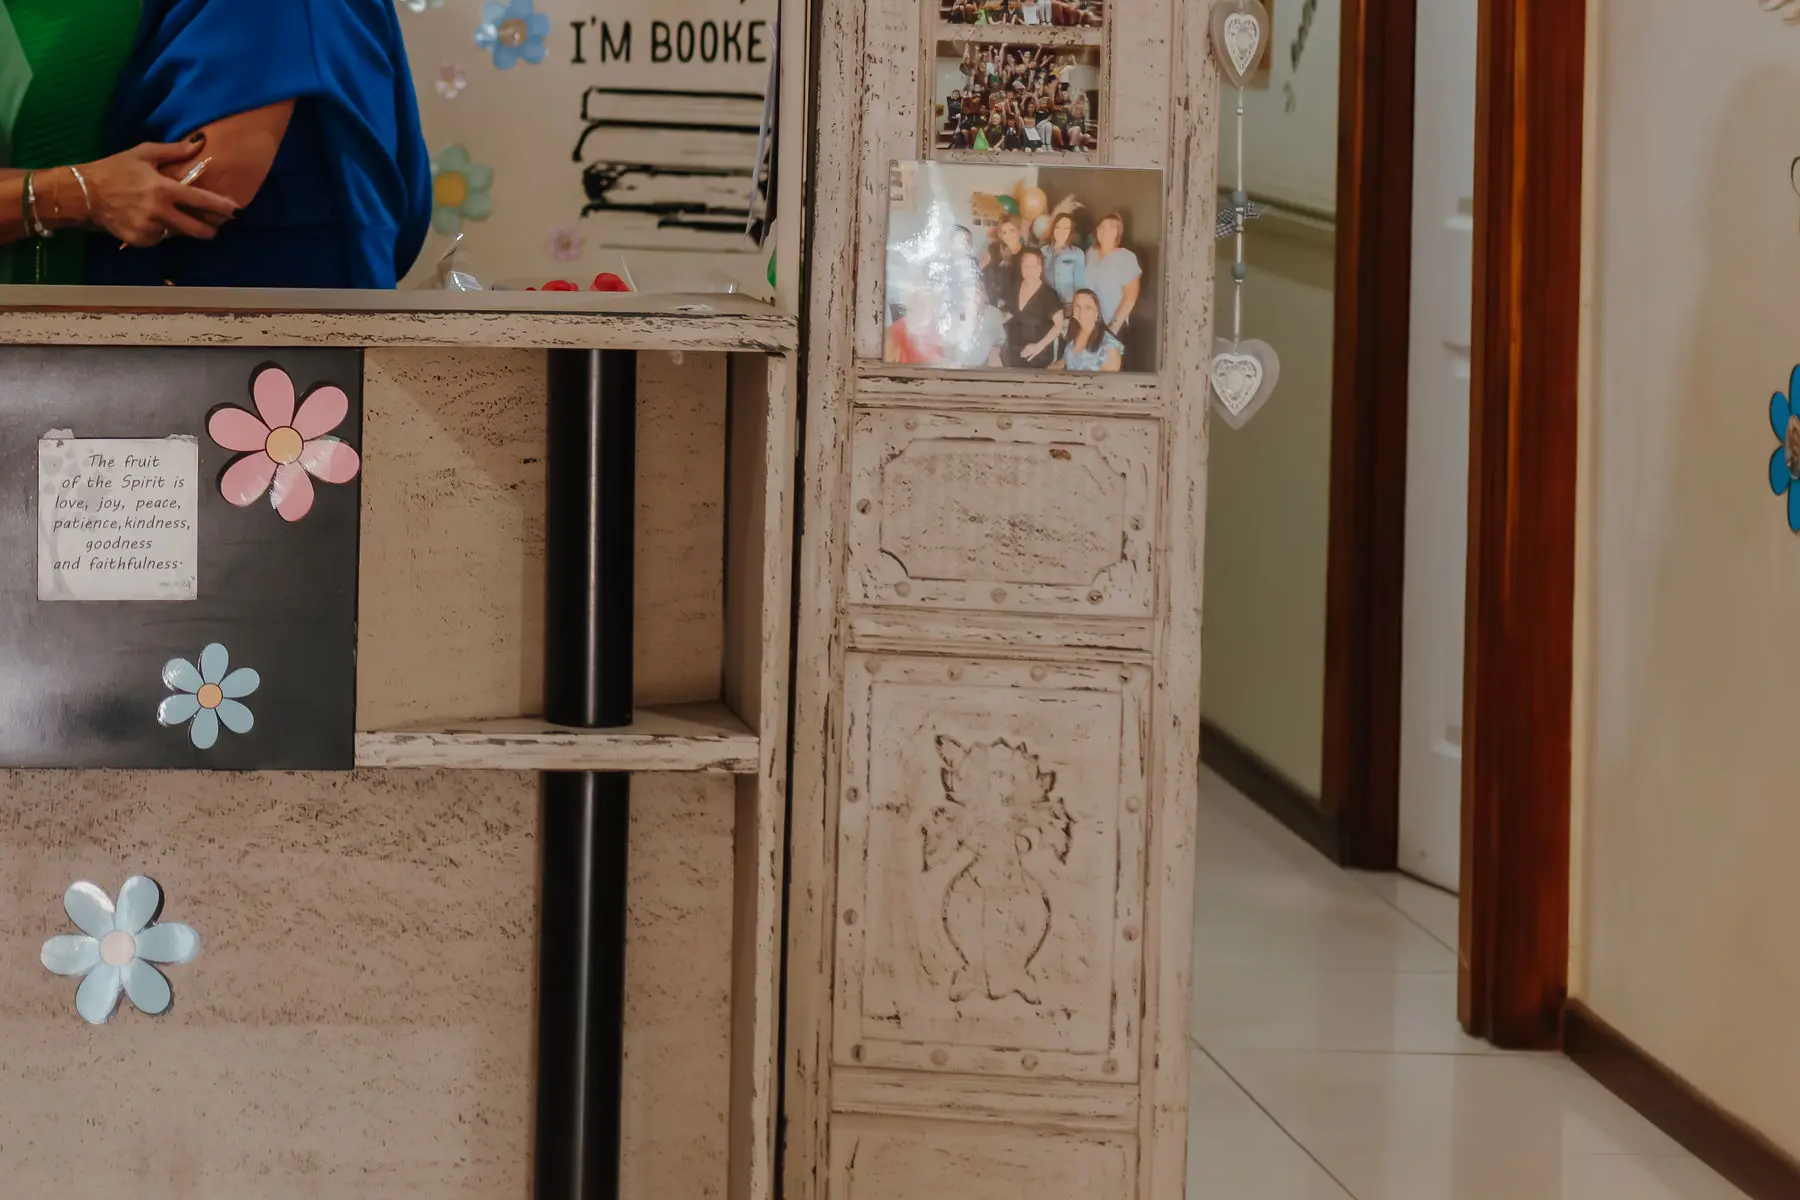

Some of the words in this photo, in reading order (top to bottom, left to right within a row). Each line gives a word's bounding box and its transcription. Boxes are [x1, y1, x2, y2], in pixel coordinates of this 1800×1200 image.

[570, 16, 632, 64] I'M
[651, 20, 768, 63] BOOKE
[88, 454, 116, 468] The
[124, 454, 160, 469] fruit
[61, 474, 81, 489] of
[87, 475, 112, 488] the
[120, 473, 165, 492] Spirit
[173, 475, 185, 488] is
[55, 496, 88, 511] love,
[96, 497, 125, 512] joy,
[135, 497, 181, 512] peace,
[53, 516, 122, 533] patience,
[124, 515, 191, 531] kindness,
[85, 535, 153, 553] goodness
[53, 555, 81, 570] and
